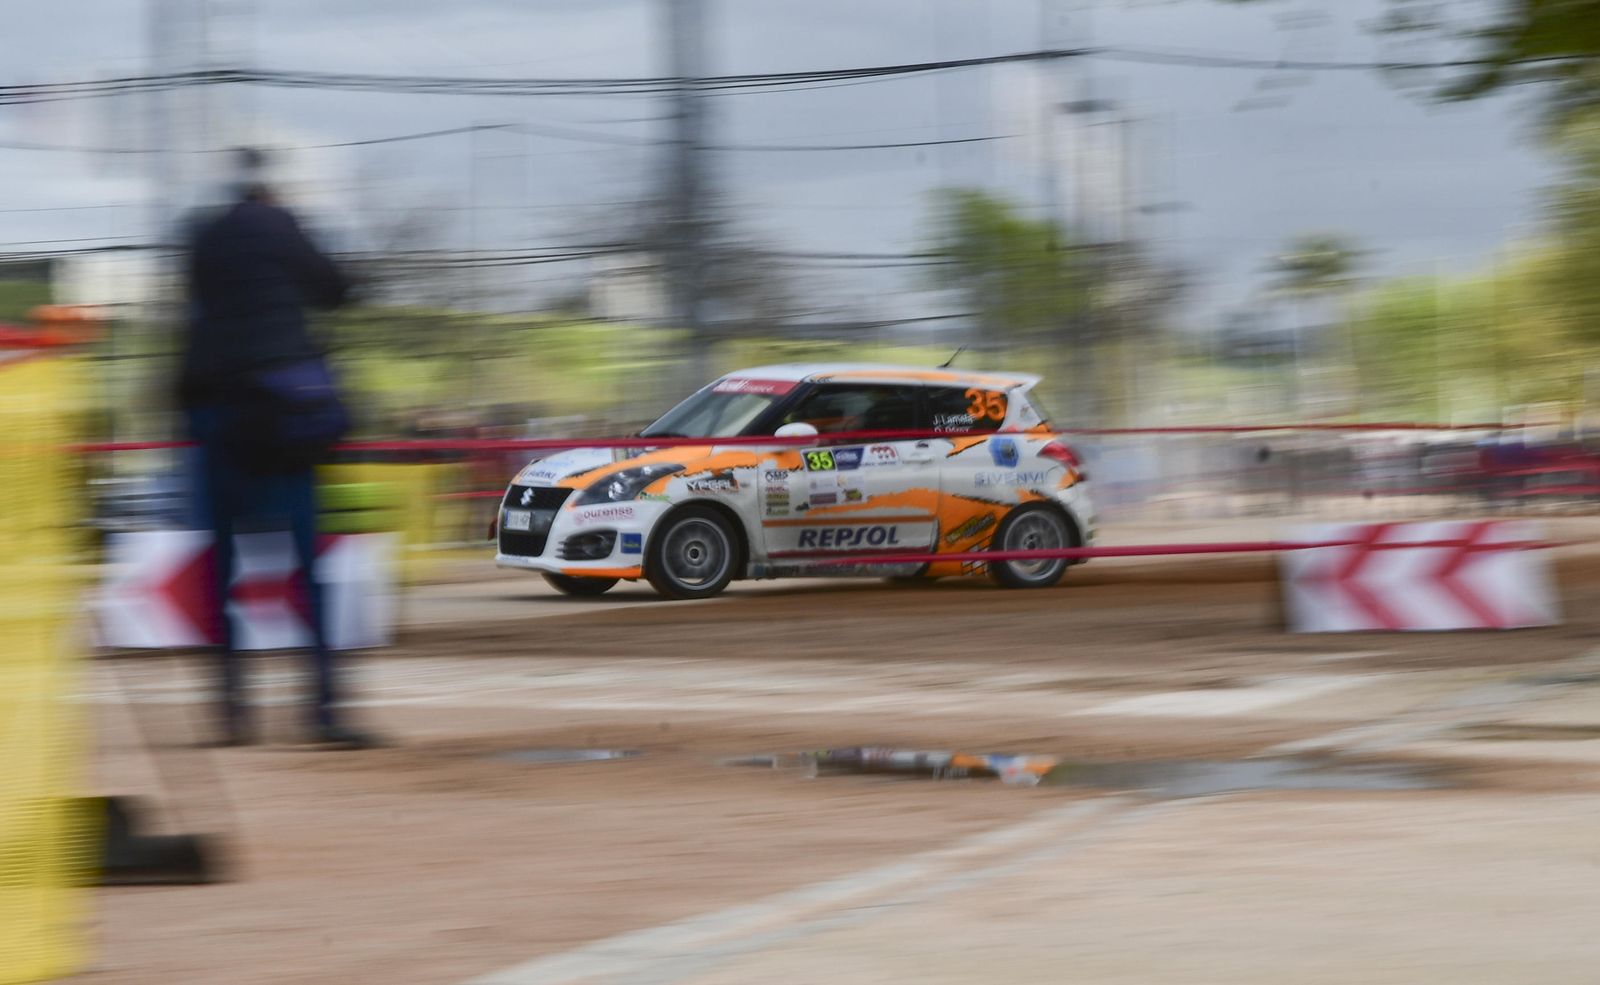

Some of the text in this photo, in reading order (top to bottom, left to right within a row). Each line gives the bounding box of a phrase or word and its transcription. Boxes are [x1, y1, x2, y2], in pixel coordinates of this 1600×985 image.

[965, 388, 1004, 420] 35
[807, 451, 833, 470] 35
[765, 471, 788, 482] OMP
[584, 507, 633, 519] ourense
[798, 526, 900, 547] REPSOL
